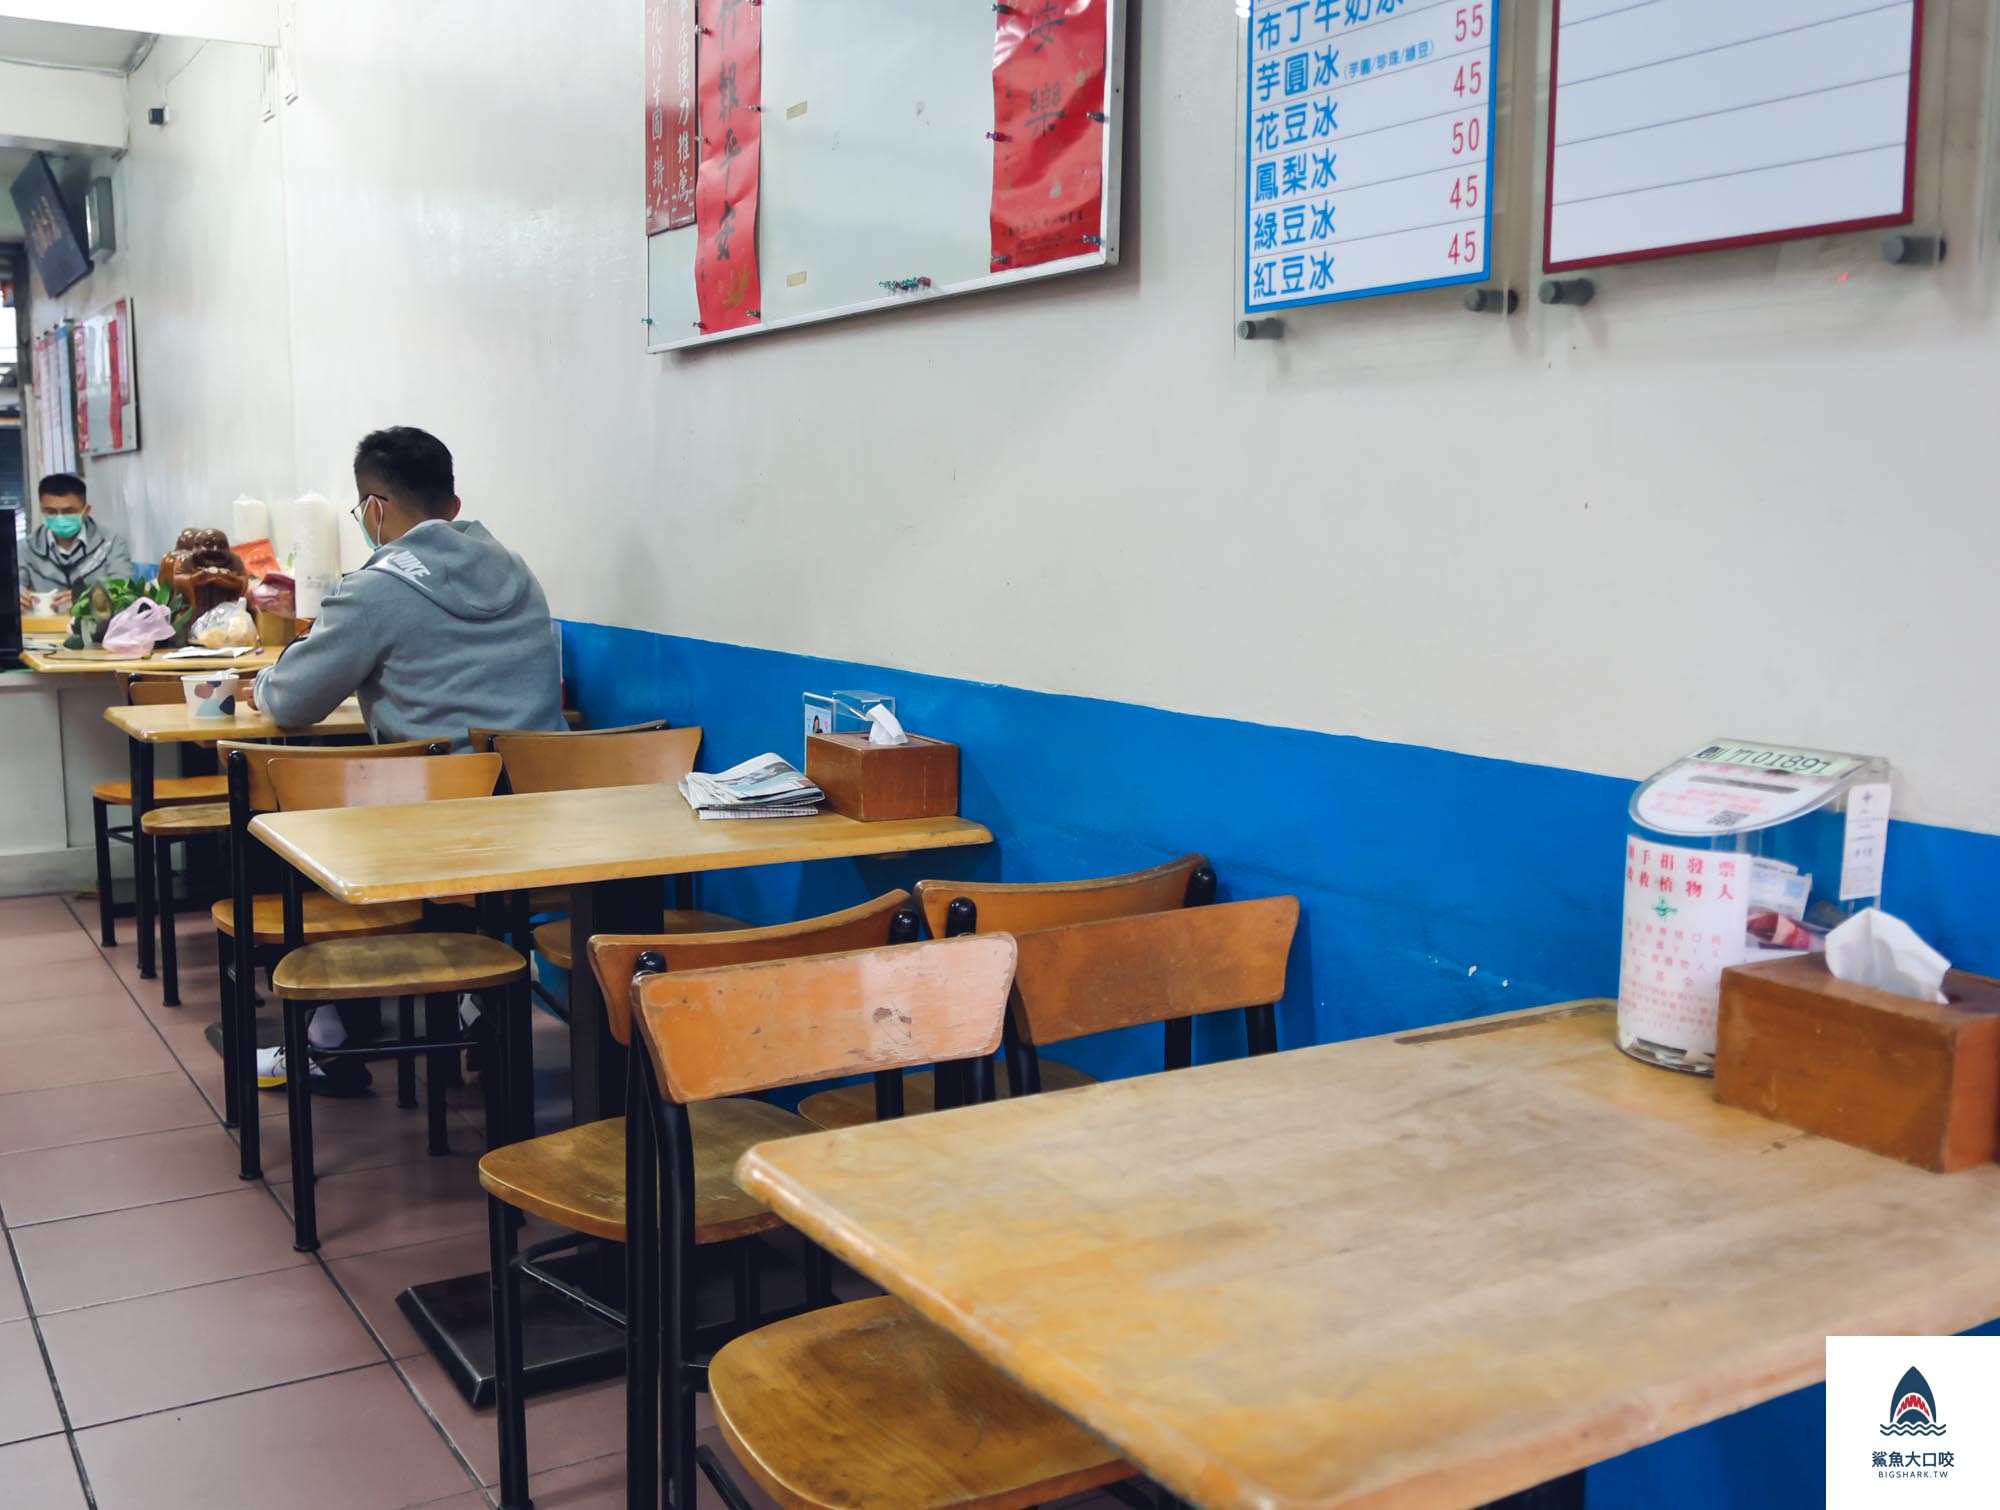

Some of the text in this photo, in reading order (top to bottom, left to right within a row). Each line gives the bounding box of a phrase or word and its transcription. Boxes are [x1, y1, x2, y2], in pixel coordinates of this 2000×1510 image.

[1256, 44, 1340, 102] 芋圓冰
[1455, 3, 1484, 42] 55
[1255, 61, 1482, 153] 花豆冰 45
[1254, 118, 1480, 203] 鳳梨冰 50
[1253, 175, 1478, 251] 綠豆冰 45
[1253, 231, 1476, 299] 紅豆冰 45
